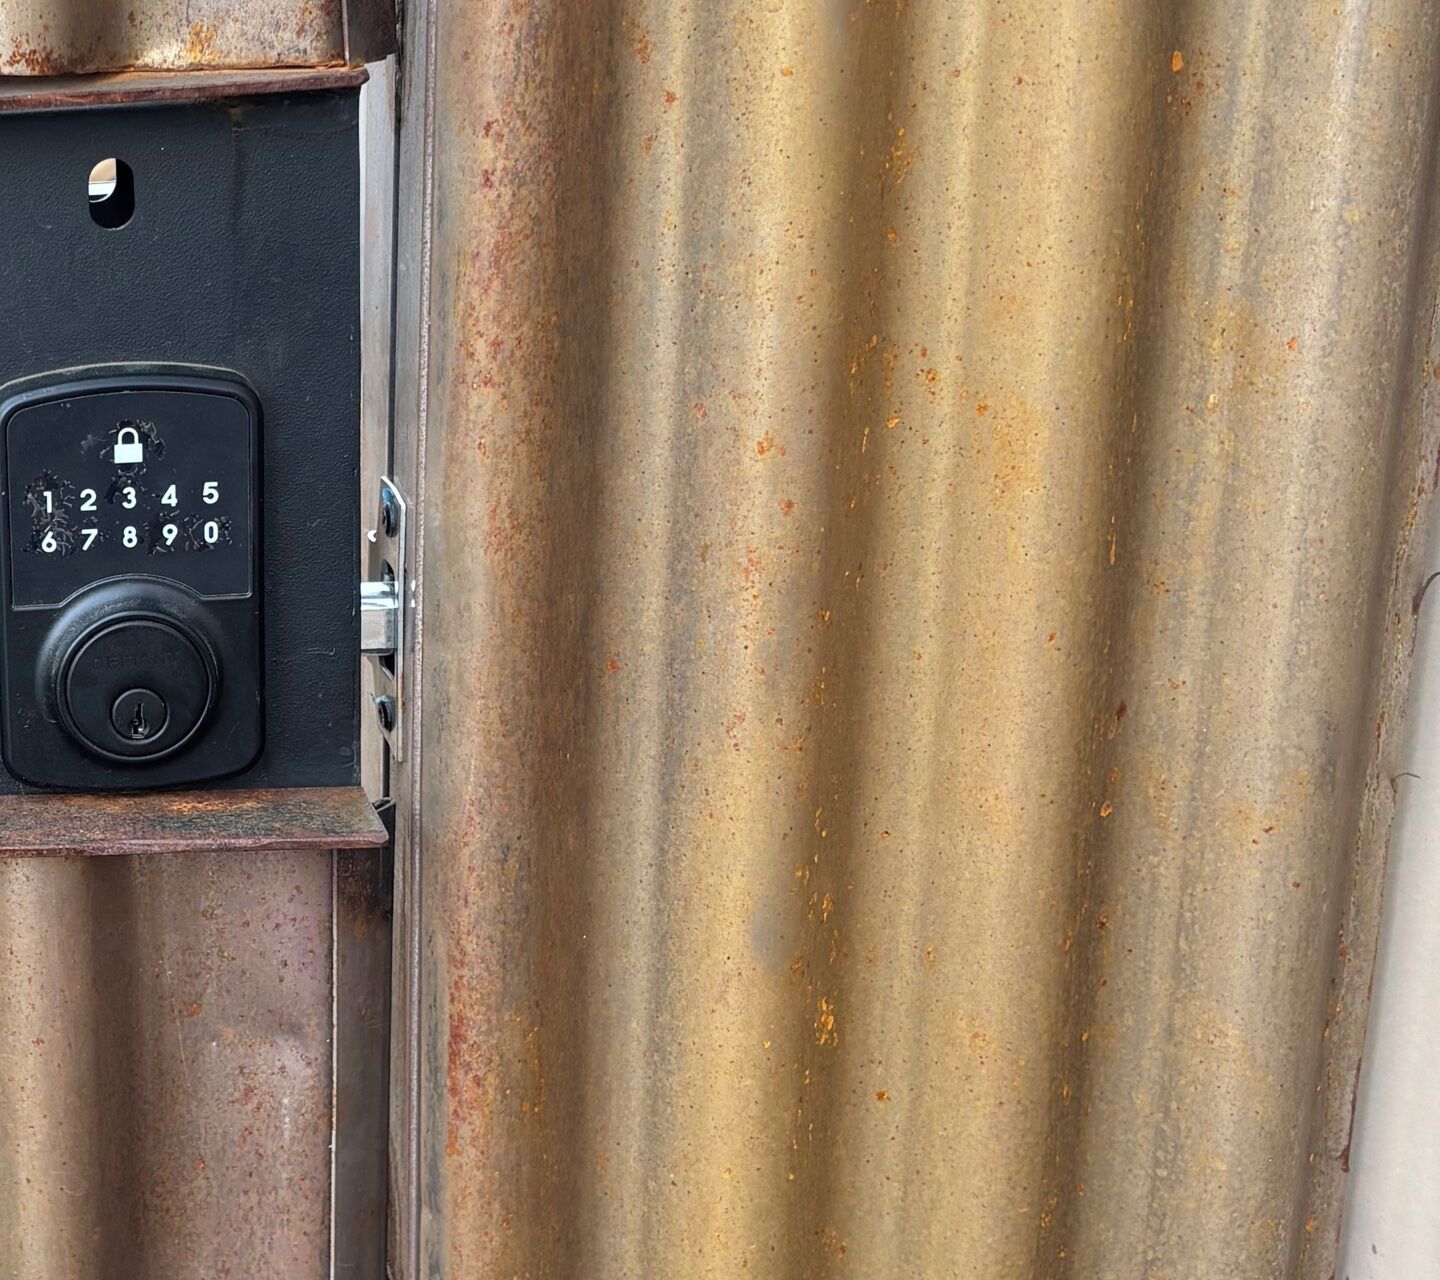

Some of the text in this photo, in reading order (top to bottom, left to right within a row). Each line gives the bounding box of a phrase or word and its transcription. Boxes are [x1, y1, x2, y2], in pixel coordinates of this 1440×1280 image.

[42, 481, 220, 514] 1 2 3 4 5
[41, 520, 219, 553] 6 7 8 9 0
